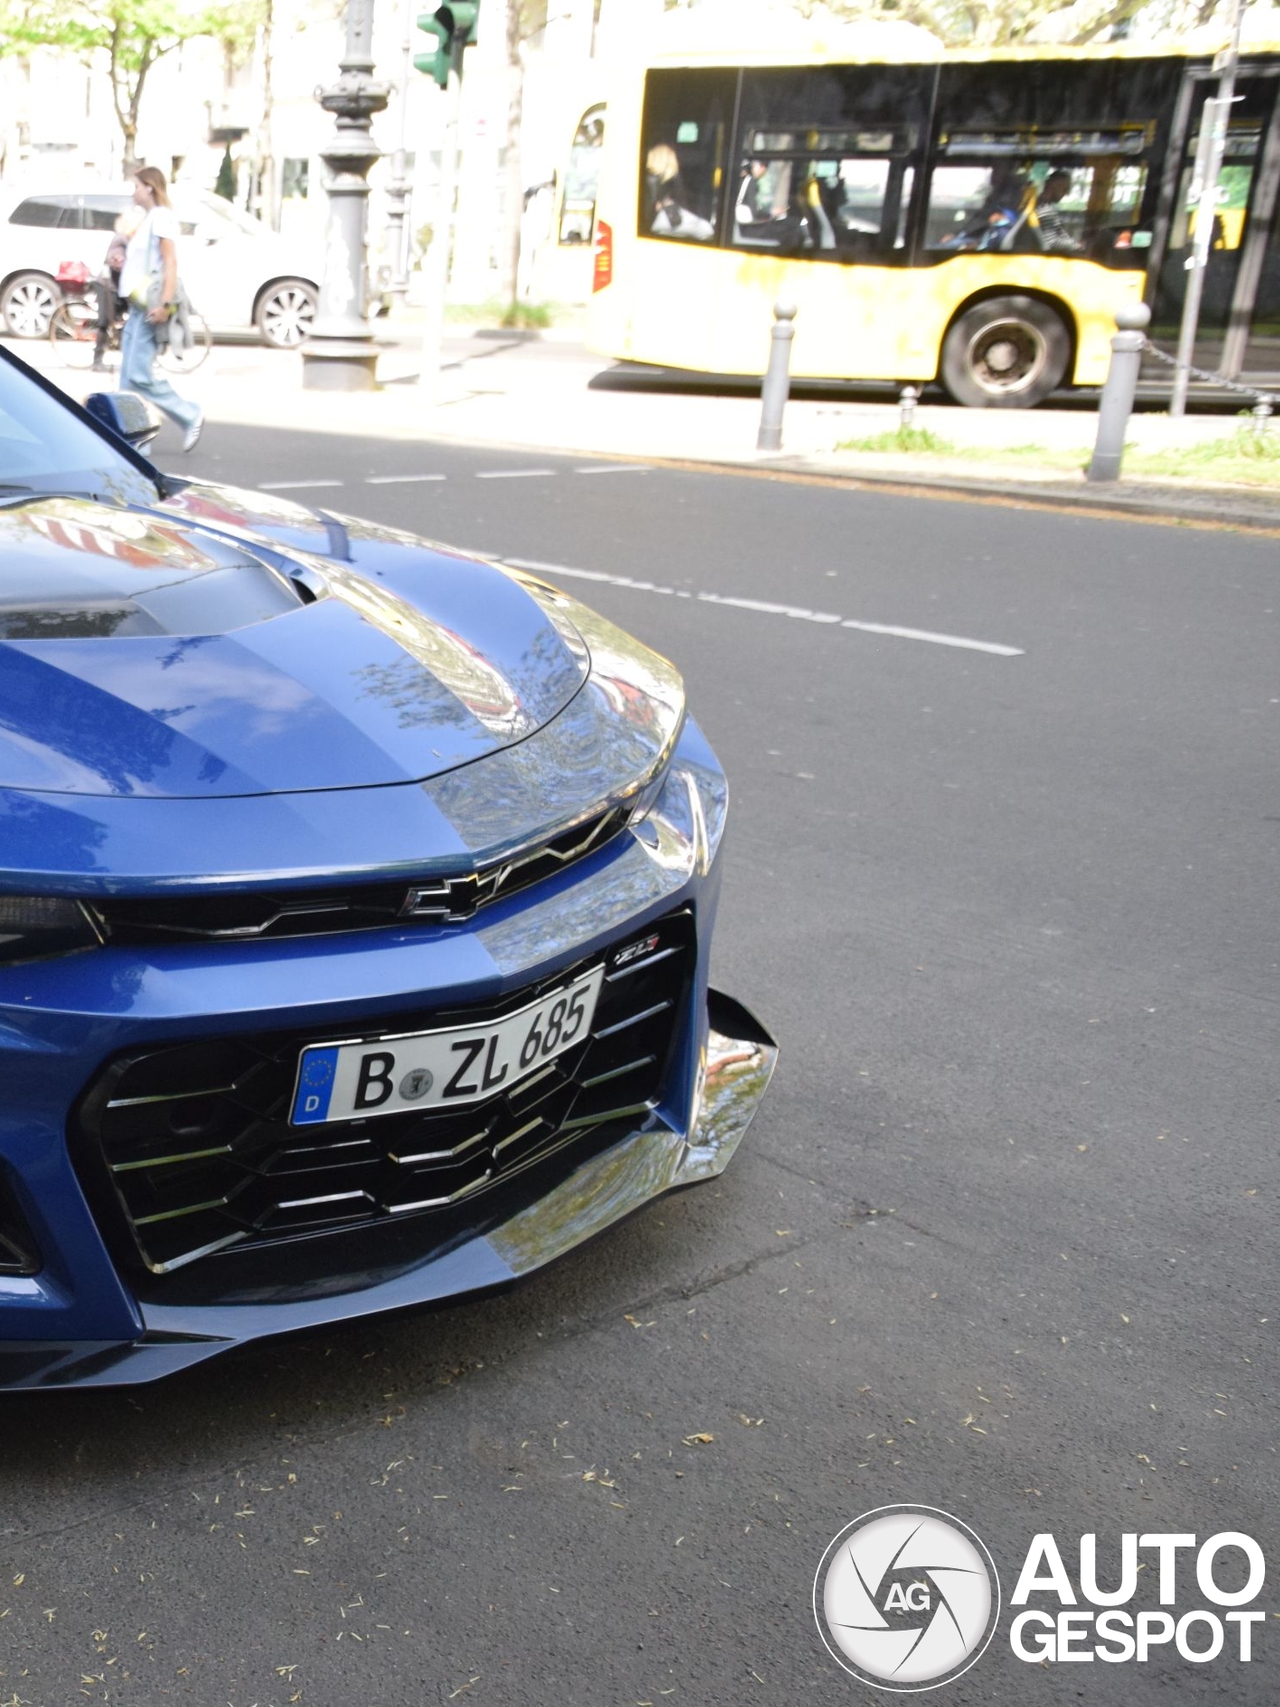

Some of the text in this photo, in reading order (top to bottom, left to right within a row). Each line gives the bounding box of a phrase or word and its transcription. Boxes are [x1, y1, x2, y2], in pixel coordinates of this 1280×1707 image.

[353, 983, 591, 1111] B ZL 685
[304, 1095, 320, 1112] D
